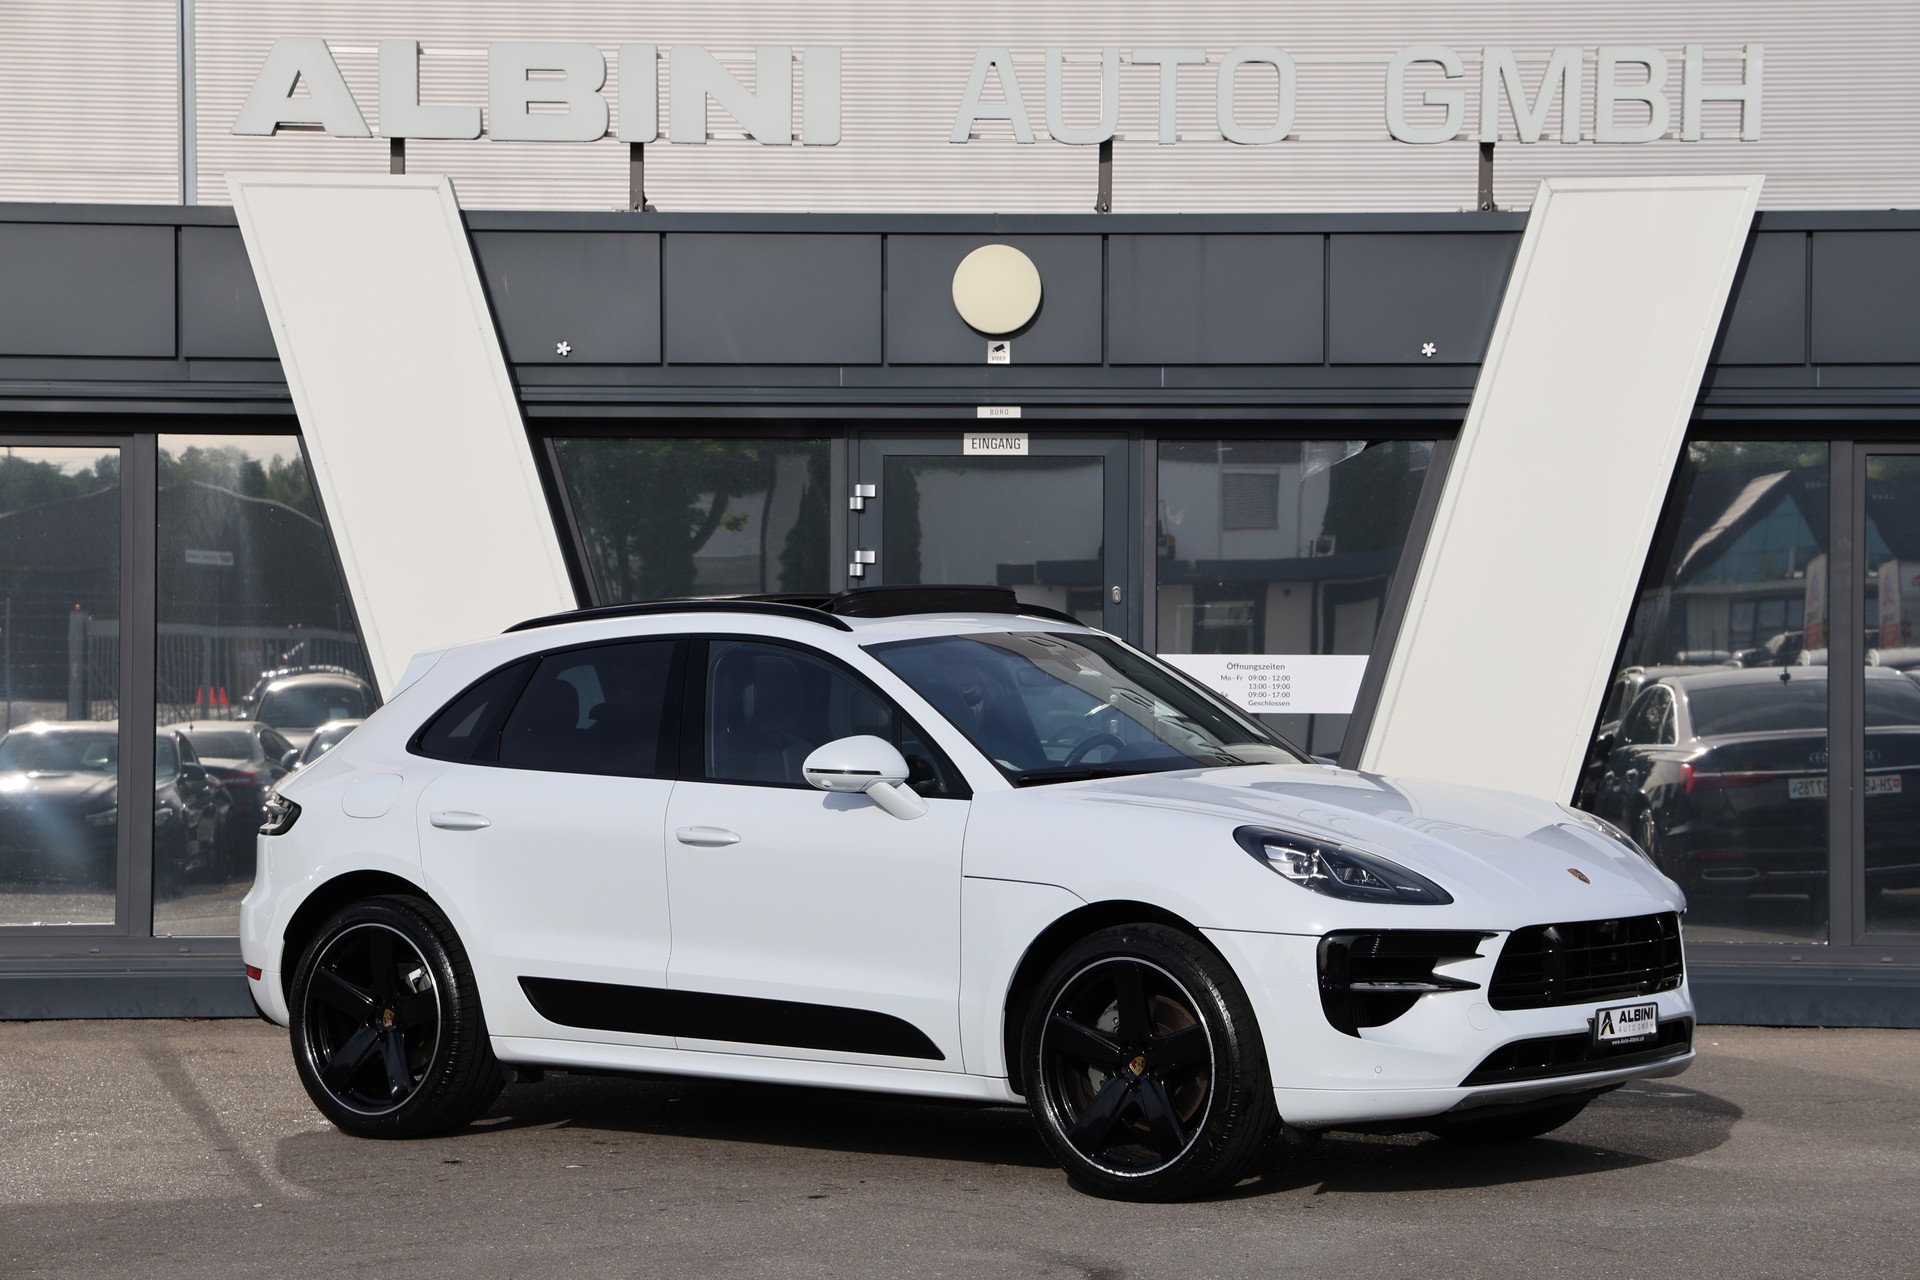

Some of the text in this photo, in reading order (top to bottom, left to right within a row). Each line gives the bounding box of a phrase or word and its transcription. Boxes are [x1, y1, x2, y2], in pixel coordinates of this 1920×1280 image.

[230, 37, 1764, 146] ALBINI AUTO GMBH
[971, 438, 1021, 450] EINGANG
[1226, 661, 1286, 671] Öffnungszeiten
[1619, 1007, 1654, 1024] ALBINI
[1618, 1023, 1636, 1033] AUTO
